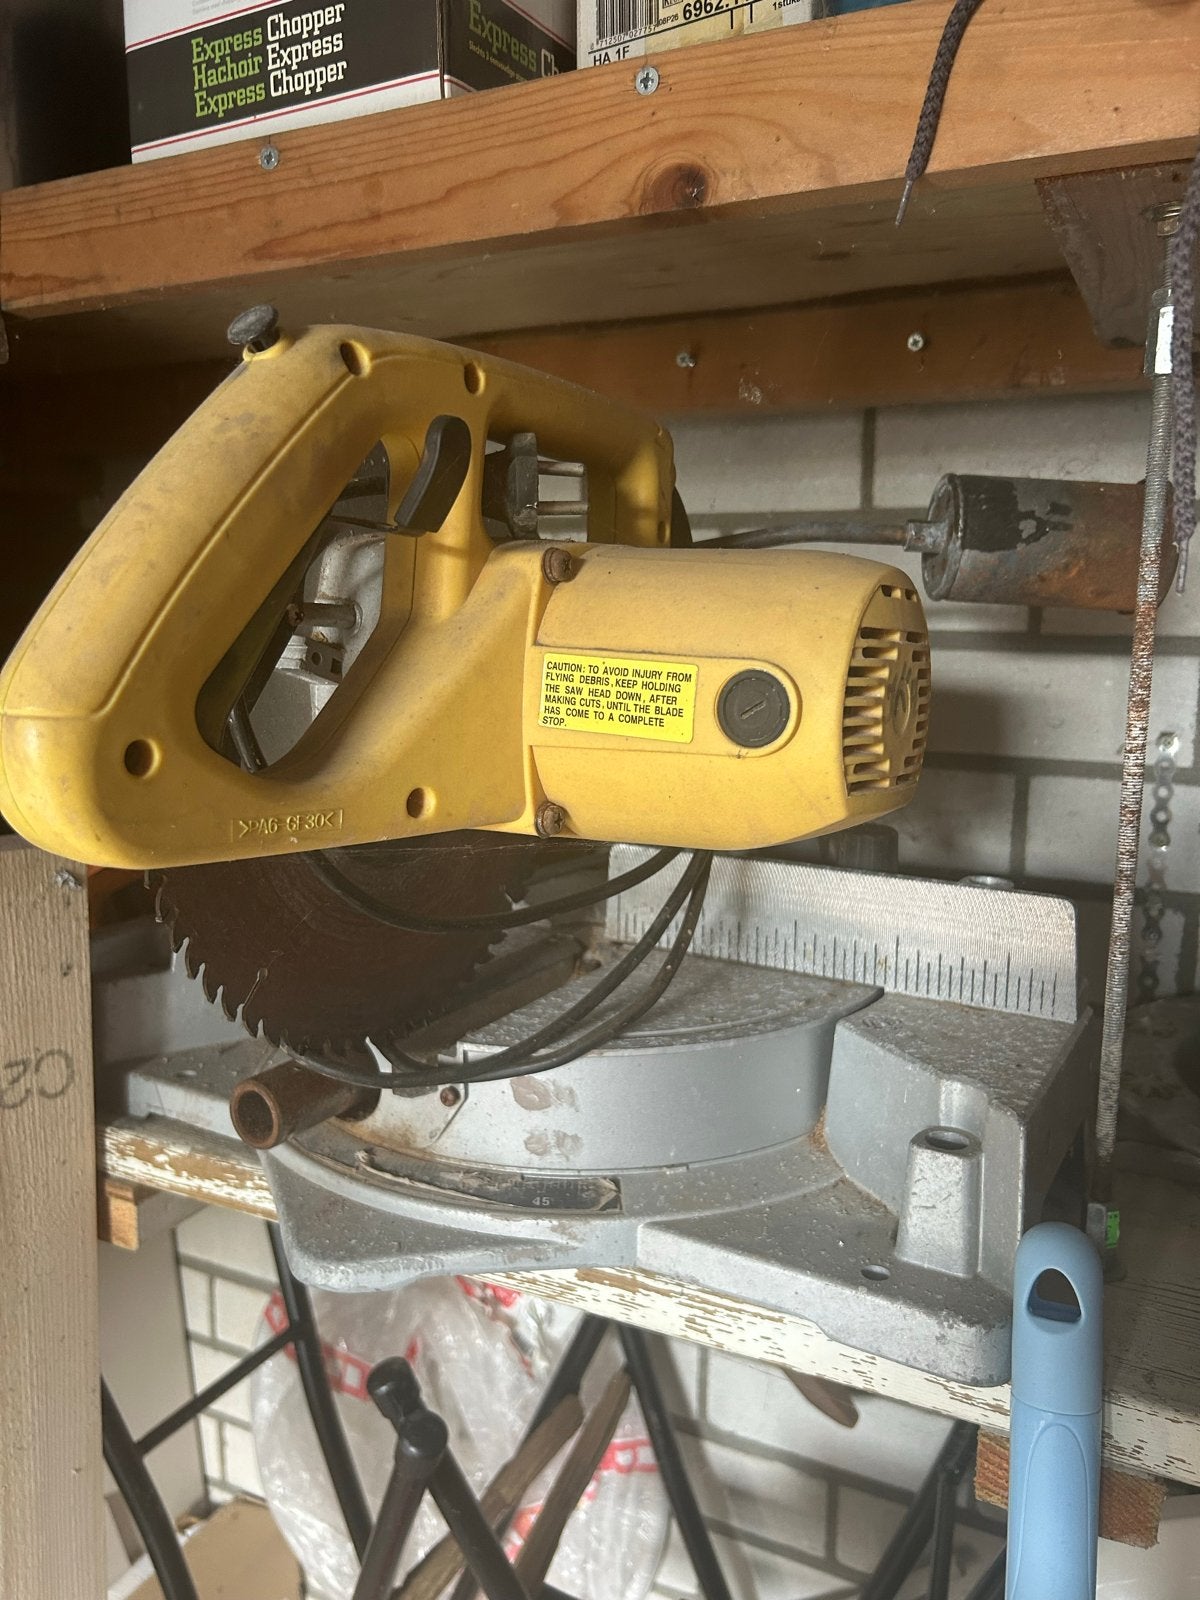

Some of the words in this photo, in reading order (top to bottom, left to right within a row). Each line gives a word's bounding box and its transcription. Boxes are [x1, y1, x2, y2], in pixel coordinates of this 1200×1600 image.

[191, 27, 263, 64] Express
[266, 3, 346, 42] Chopper
[468, 0, 537, 73] Express
[192, 52, 263, 91] Hachoir
[266, 32, 344, 71] Express
[593, 51, 612, 67] HA
[615, 45, 630, 60] 1F
[194, 82, 266, 118] Express
[269, 60, 348, 98] Chopper
[545, 672, 574, 683] FLYING
[615, 677, 637, 688] KEEP
[641, 680, 681, 693] HOLDING
[546, 661, 585, 673] CAUTION:
[588, 664, 599, 674] TO
[602, 666, 629, 677] AVOID
[632, 668, 663, 680] INJURY
[666, 671, 692, 683] FROM
[545, 683, 560, 694] THE
[564, 685, 584, 696] SAW
[588, 687, 611, 699] HEAD
[649, 694, 678, 705] AFTER
[544, 694, 576, 706] MAKING
[606, 700, 631, 713] UNTIL
[633, 703, 650, 714] THE
[654, 705, 684, 718] BLADE
[544, 705, 561, 716] HAS
[565, 707, 590, 719] COME
[593, 711, 605, 721] TO
[608, 712, 615, 722] A
[618, 713, 665, 728] COMPLETE
[542, 716, 567, 727] STOP.
[531, 1196, 551, 1206] 45
